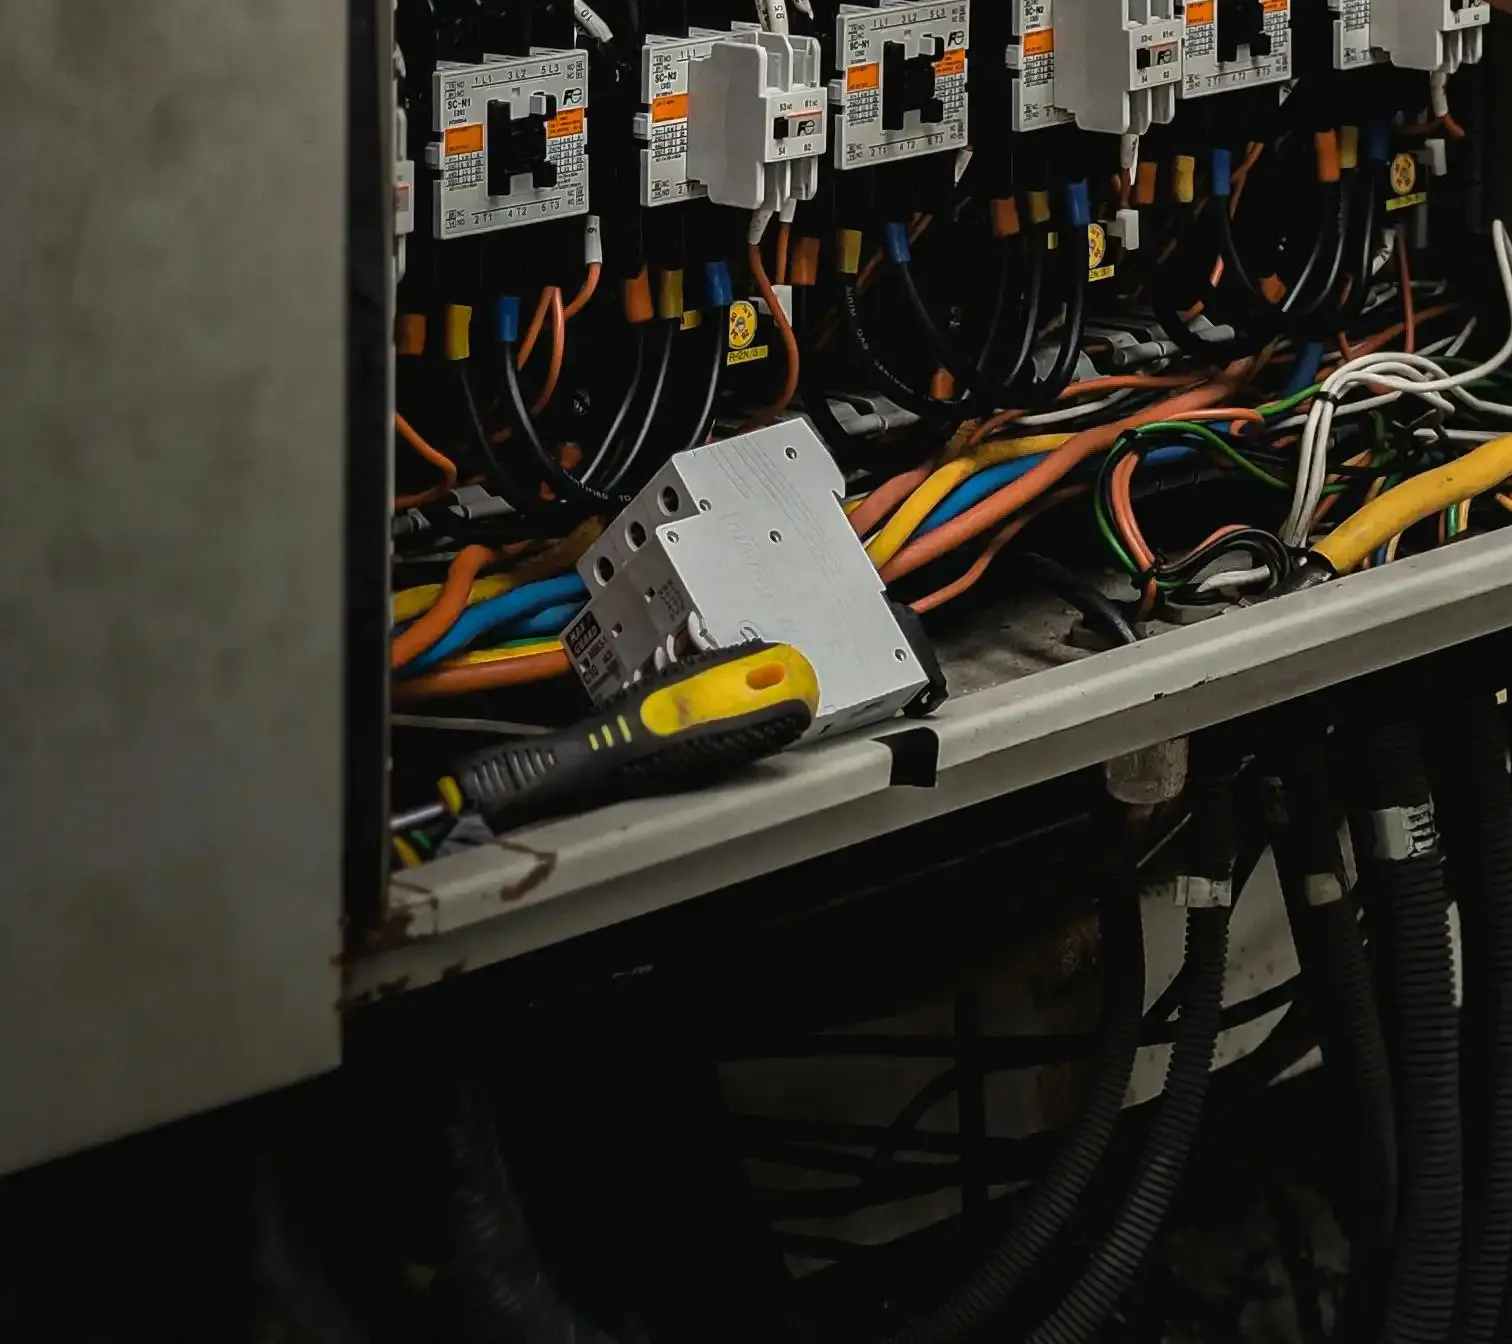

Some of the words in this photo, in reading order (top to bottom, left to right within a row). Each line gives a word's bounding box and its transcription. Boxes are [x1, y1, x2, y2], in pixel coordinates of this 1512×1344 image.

[580, 9, 593, 22] 10
[774, 4, 785, 20] 95
[908, 12, 918, 22] L2
[474, 76, 479, 85] 1
[482, 75, 493, 84] L1
[507, 71, 513, 80] 3
[515, 69, 527, 79] L2
[541, 65, 546, 74] 5
[548, 63, 560, 73] L3
[654, 71, 678, 84] SC-N2
[447, 97, 472, 110] SC-N1
[474, 214, 480, 225] 2
[483, 213, 493, 223] T1
[507, 209, 513, 218] 4
[516, 207, 528, 216] T2
[541, 203, 547, 212] 6
[549, 201, 561, 210] T3
